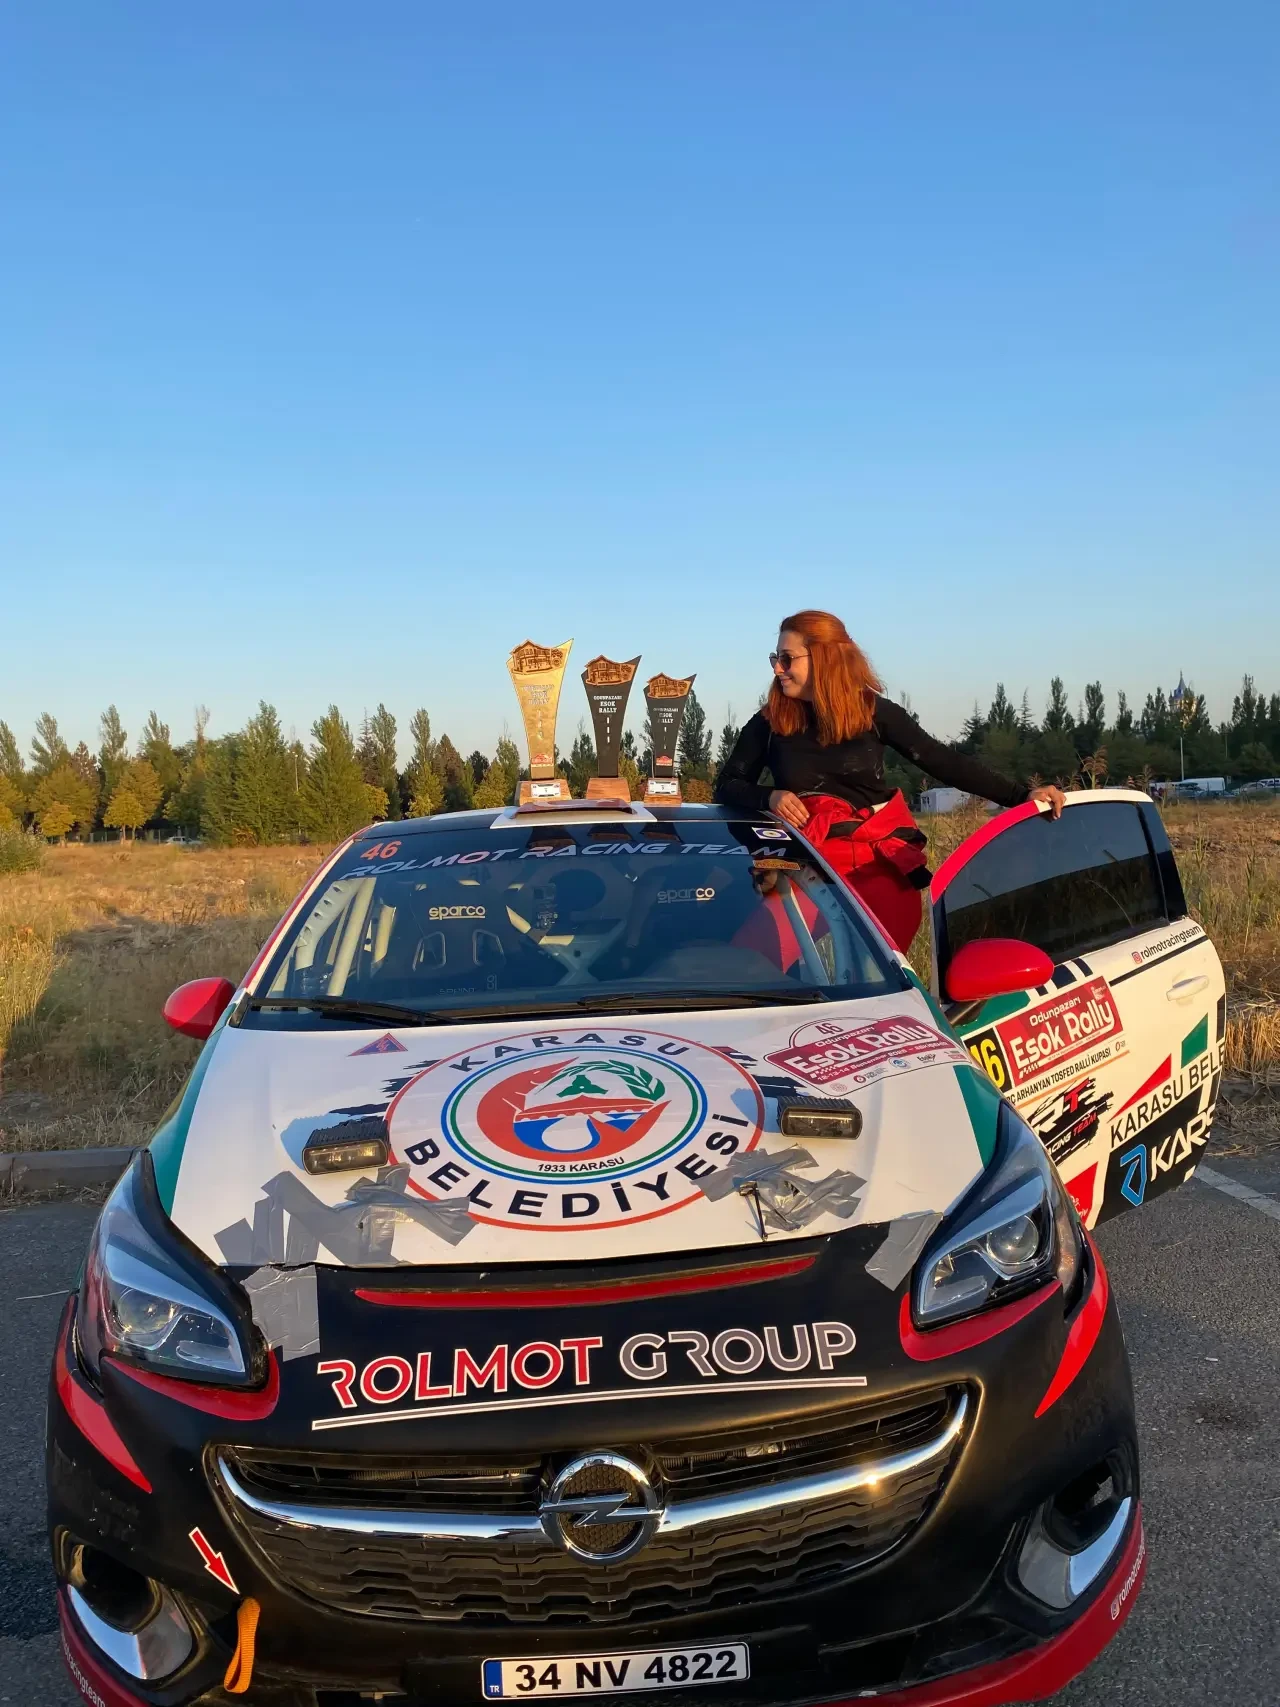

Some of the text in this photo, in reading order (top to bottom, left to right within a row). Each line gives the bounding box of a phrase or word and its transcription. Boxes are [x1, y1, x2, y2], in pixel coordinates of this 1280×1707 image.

[338, 842, 786, 881] ROLMOT RACING TEAM
[360, 841, 402, 860] 46
[428, 905, 486, 921] sparco
[657, 887, 715, 904] sparco
[1140, 925, 1202, 960] rolmotracingteam
[817, 1022, 844, 1036] 46
[1029, 996, 1081, 1027] Odunpazarı
[448, 1032, 690, 1073] KARASU
[784, 1024, 934, 1075] Esok Rally
[1009, 1021, 1066, 1070] Esok
[1062, 998, 1115, 1043] Rally
[1016, 1079, 1052, 1103] ARHANYAN
[1051, 1066, 1075, 1087] TOSFED
[1091, 1047, 1112, 1067] KUPASI
[1073, 1111, 1097, 1137] TEAM
[1111, 1075, 1183, 1149] KARASU
[403, 1112, 750, 1220] BELEDİYESİ
[537, 1156, 625, 1173] 1933 KARASU
[316, 1321, 857, 1408] ROLMOT GROUP
[490, 1685, 500, 1693] TR
[515, 1650, 737, 1692] 34 NV 4822
